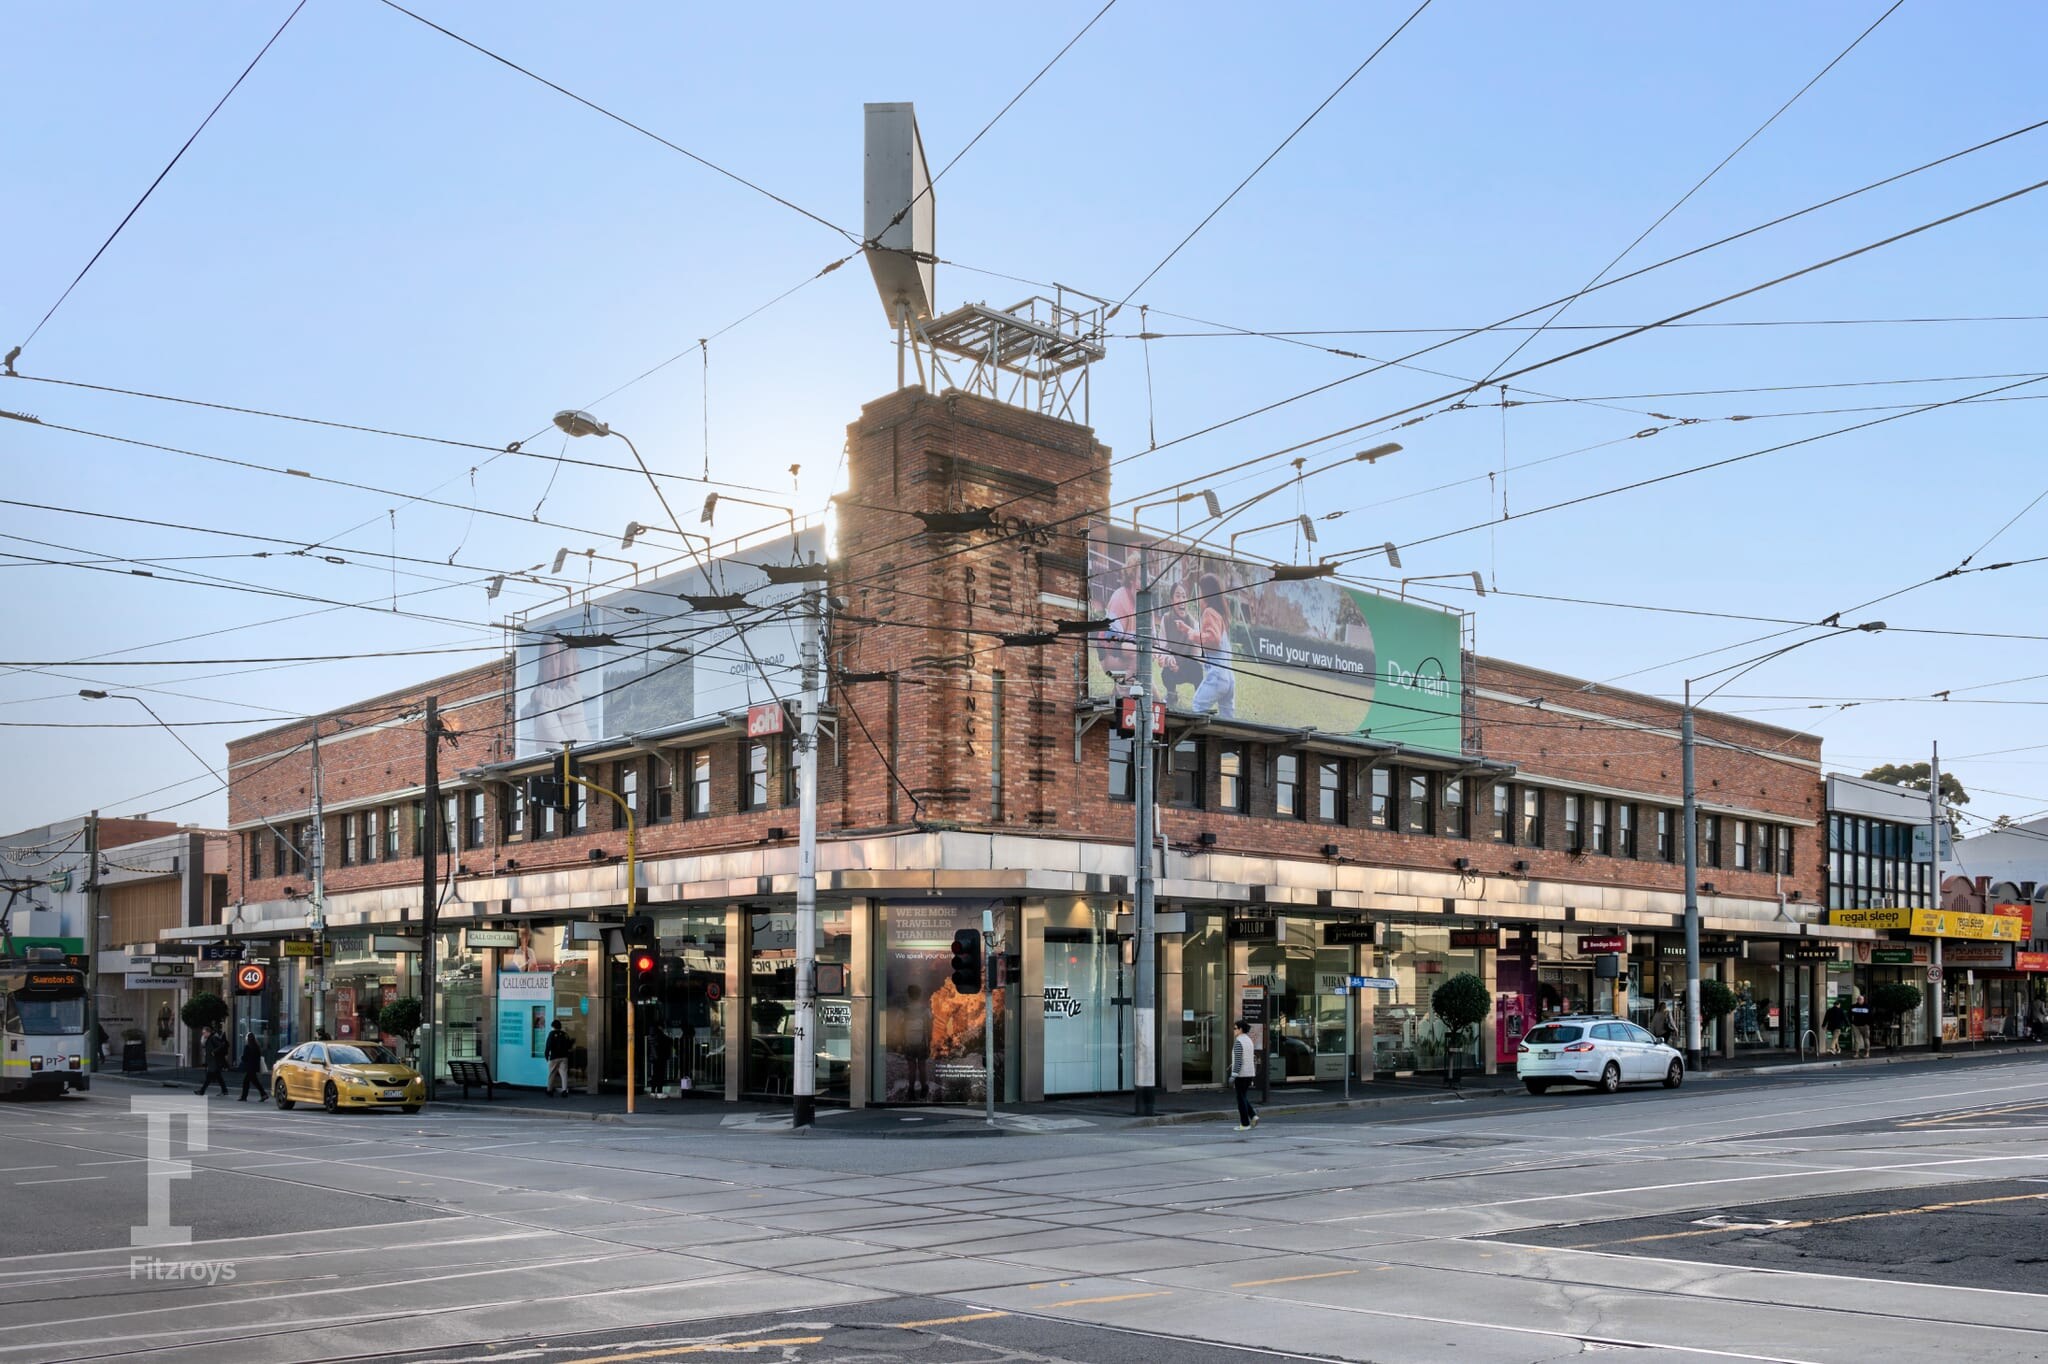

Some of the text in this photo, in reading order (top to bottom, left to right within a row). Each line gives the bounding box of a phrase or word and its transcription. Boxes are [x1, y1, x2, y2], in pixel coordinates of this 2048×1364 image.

[764, 653, 785, 667] ROAD
[1259, 637, 1364, 674] Find your way home
[1388, 660, 1450, 699] Domain
[896, 908, 957, 917] WE'RE MORE
[1840, 910, 1899, 924] regal sleep
[896, 919, 952, 928] TRAVELLER
[1239, 921, 1265, 934] DILLON
[896, 930, 923, 939] THAN
[1590, 941, 1609, 949] Bendigo
[210, 948, 237, 958] BUFF
[907, 952, 923, 960] speak
[33, 976, 75, 984] Swanston St
[244, 972, 260, 983] 40
[503, 977, 519, 989] CALL
[527, 977, 549, 989] CLARE
